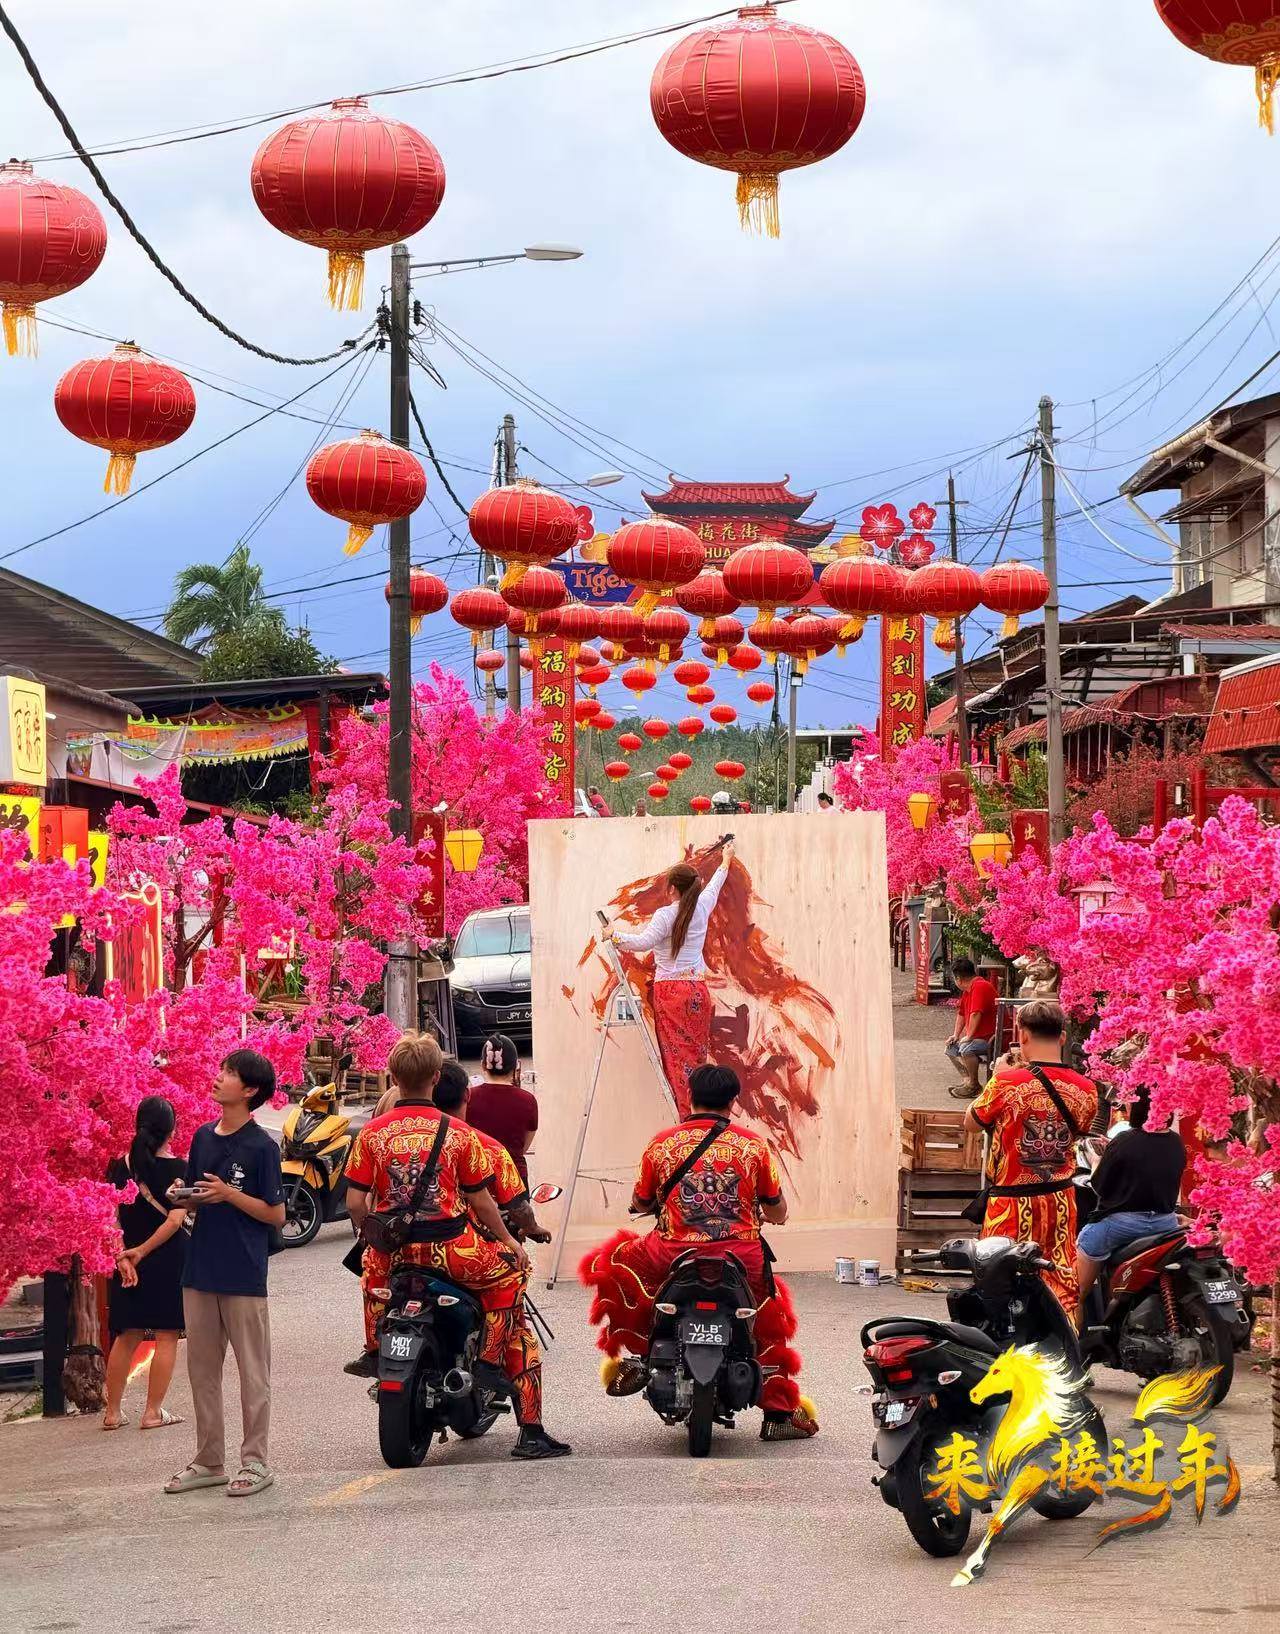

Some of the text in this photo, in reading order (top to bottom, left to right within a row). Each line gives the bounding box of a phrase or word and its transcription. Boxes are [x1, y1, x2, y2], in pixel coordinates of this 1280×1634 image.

[698, 522, 760, 541] 梅花街
[704, 547, 731, 559] HUA
[506, 1011, 520, 1020] JPY
[1208, 1290, 1237, 1300] 3299
[693, 1324, 719, 1334] VLB
[688, 1332, 723, 1343] 7226
[390, 1345, 411, 1357] 7121
